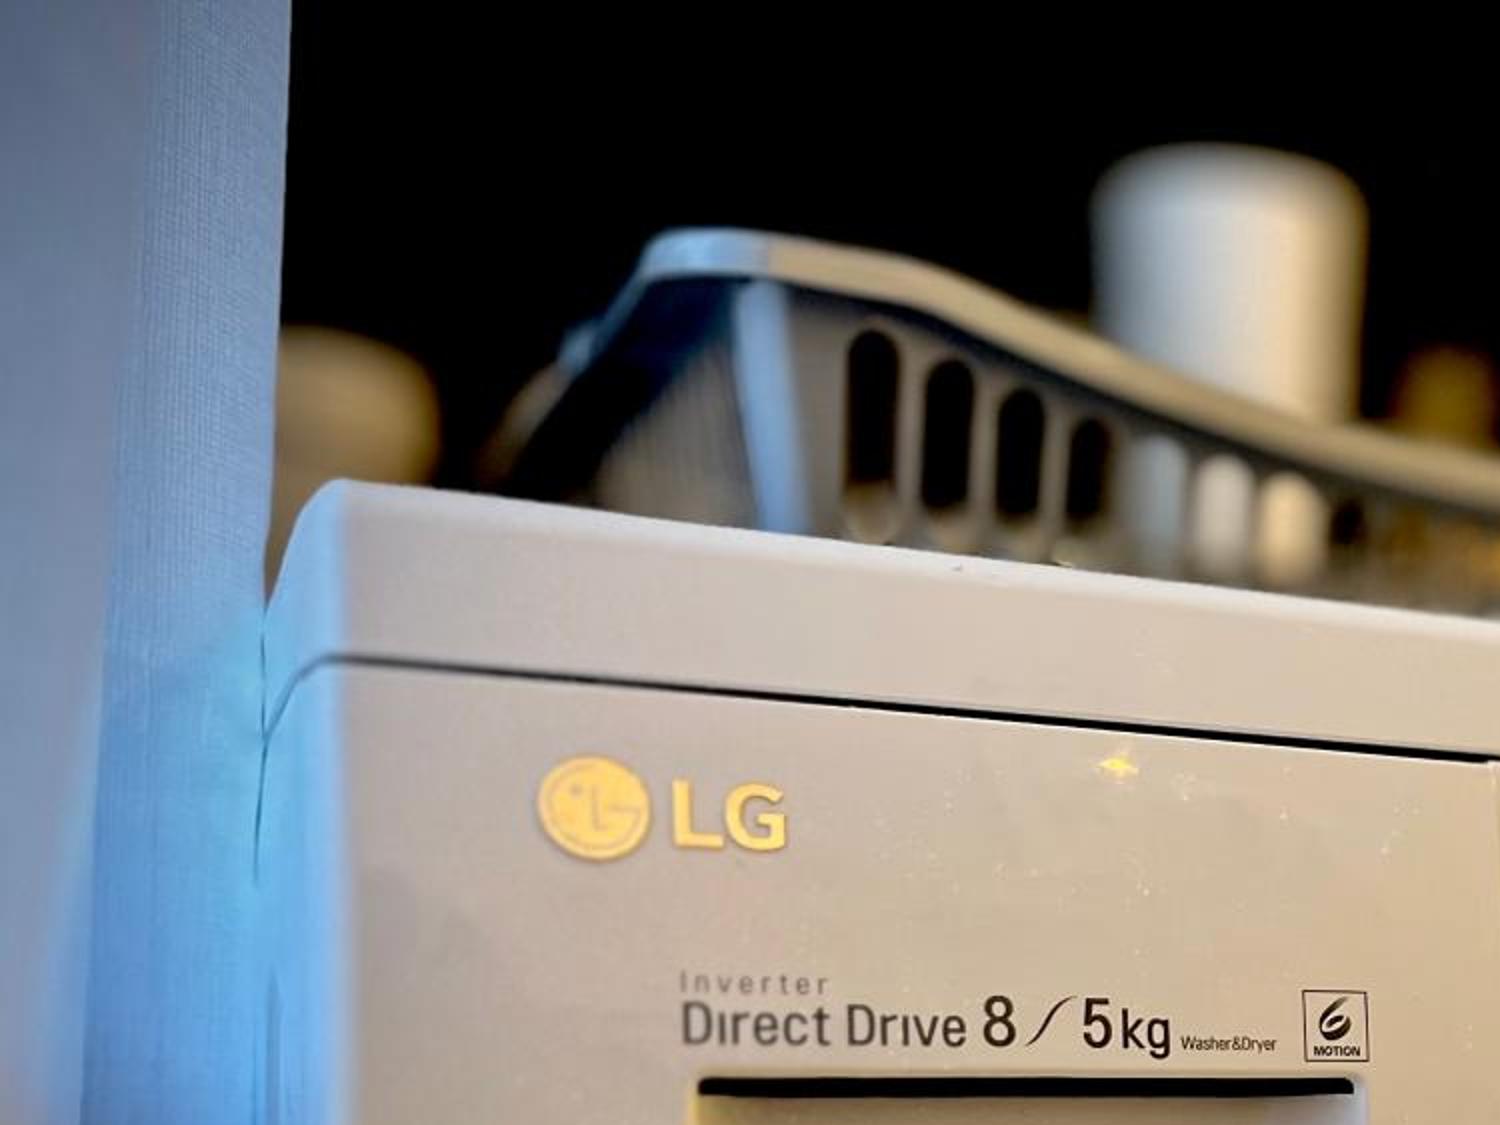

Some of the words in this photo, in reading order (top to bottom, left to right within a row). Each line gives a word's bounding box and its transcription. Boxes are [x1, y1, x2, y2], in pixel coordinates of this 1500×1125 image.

[672, 778, 787, 852] LG
[679, 970, 829, 996] Inverter
[682, 1001, 831, 1047] Direct
[847, 1004, 967, 1048] Drive
[1179, 1035, 1278, 1055] Washer&Dryer
[1313, 1045, 1361, 1057] MOTION
